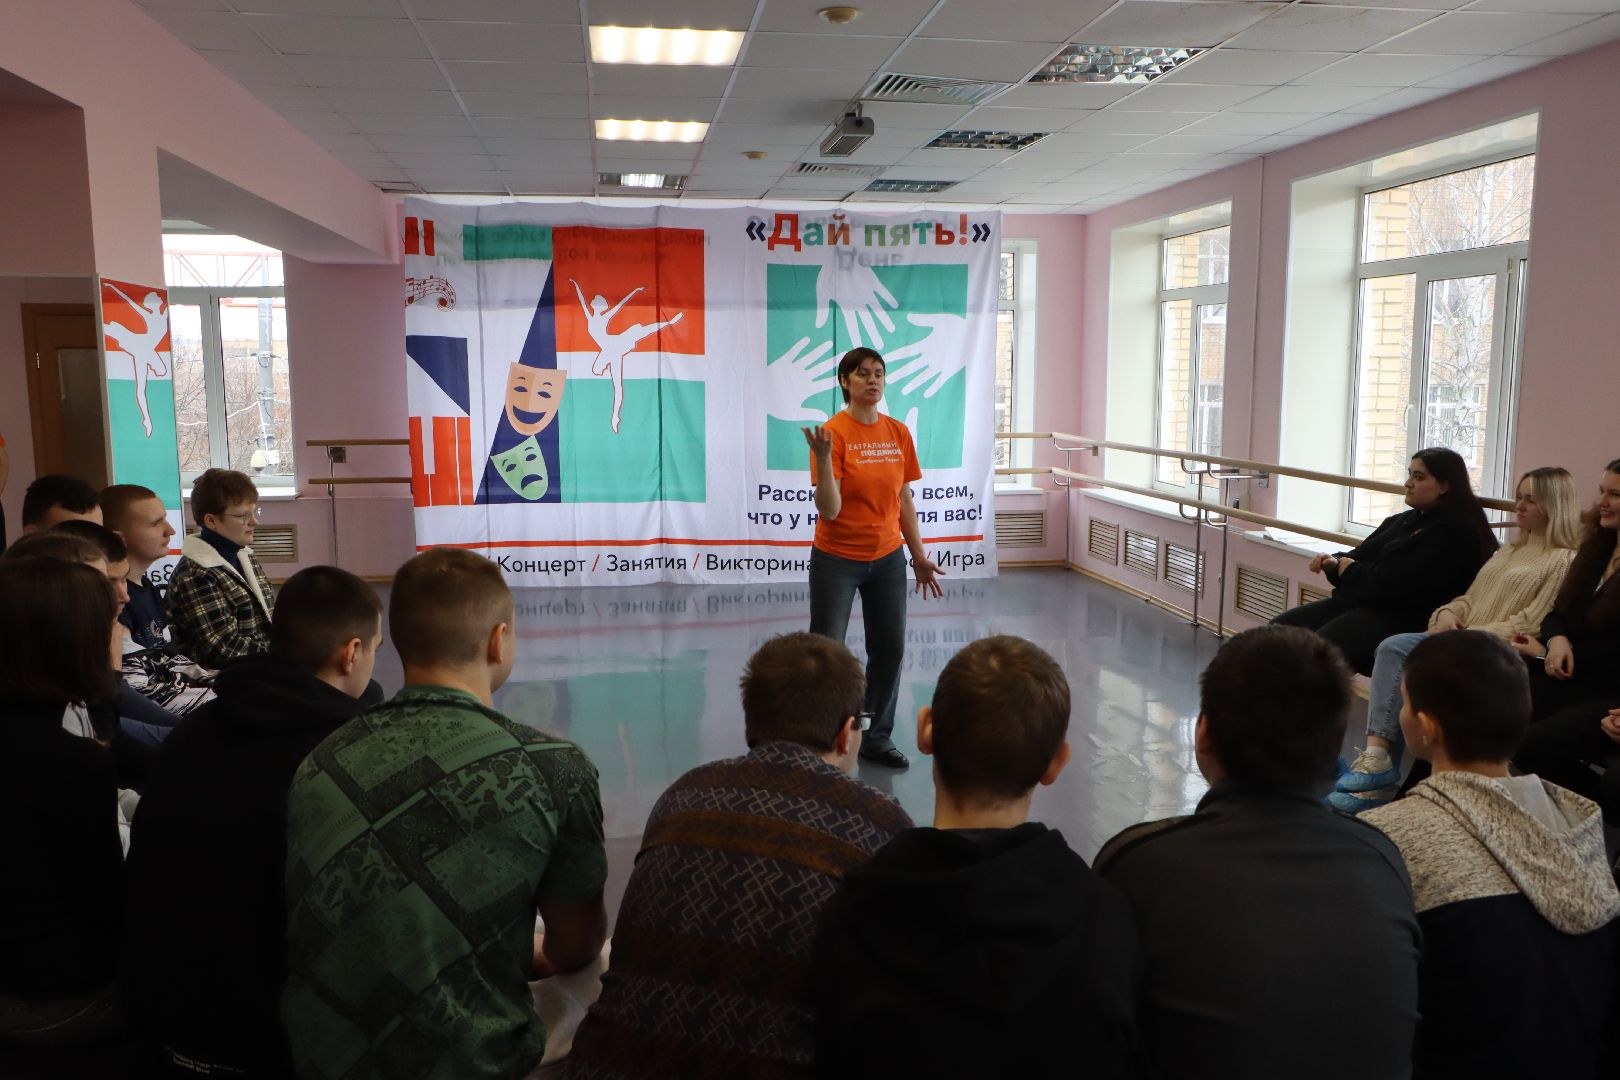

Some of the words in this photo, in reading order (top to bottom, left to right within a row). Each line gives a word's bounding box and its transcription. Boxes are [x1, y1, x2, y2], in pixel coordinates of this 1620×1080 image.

[745, 213, 850, 252] «Дай
[864, 213, 991, 247] пять!»
[758, 484, 816, 502] Расск
[922, 485, 974, 500] всем,
[747, 511, 783, 526] что
[789, 513, 801, 530] у
[916, 510, 938, 523] ля
[944, 503, 983, 522] вас!
[497, 555, 586, 577] Концерт
[606, 554, 687, 572] Занятия
[937, 550, 985, 571] Игра
